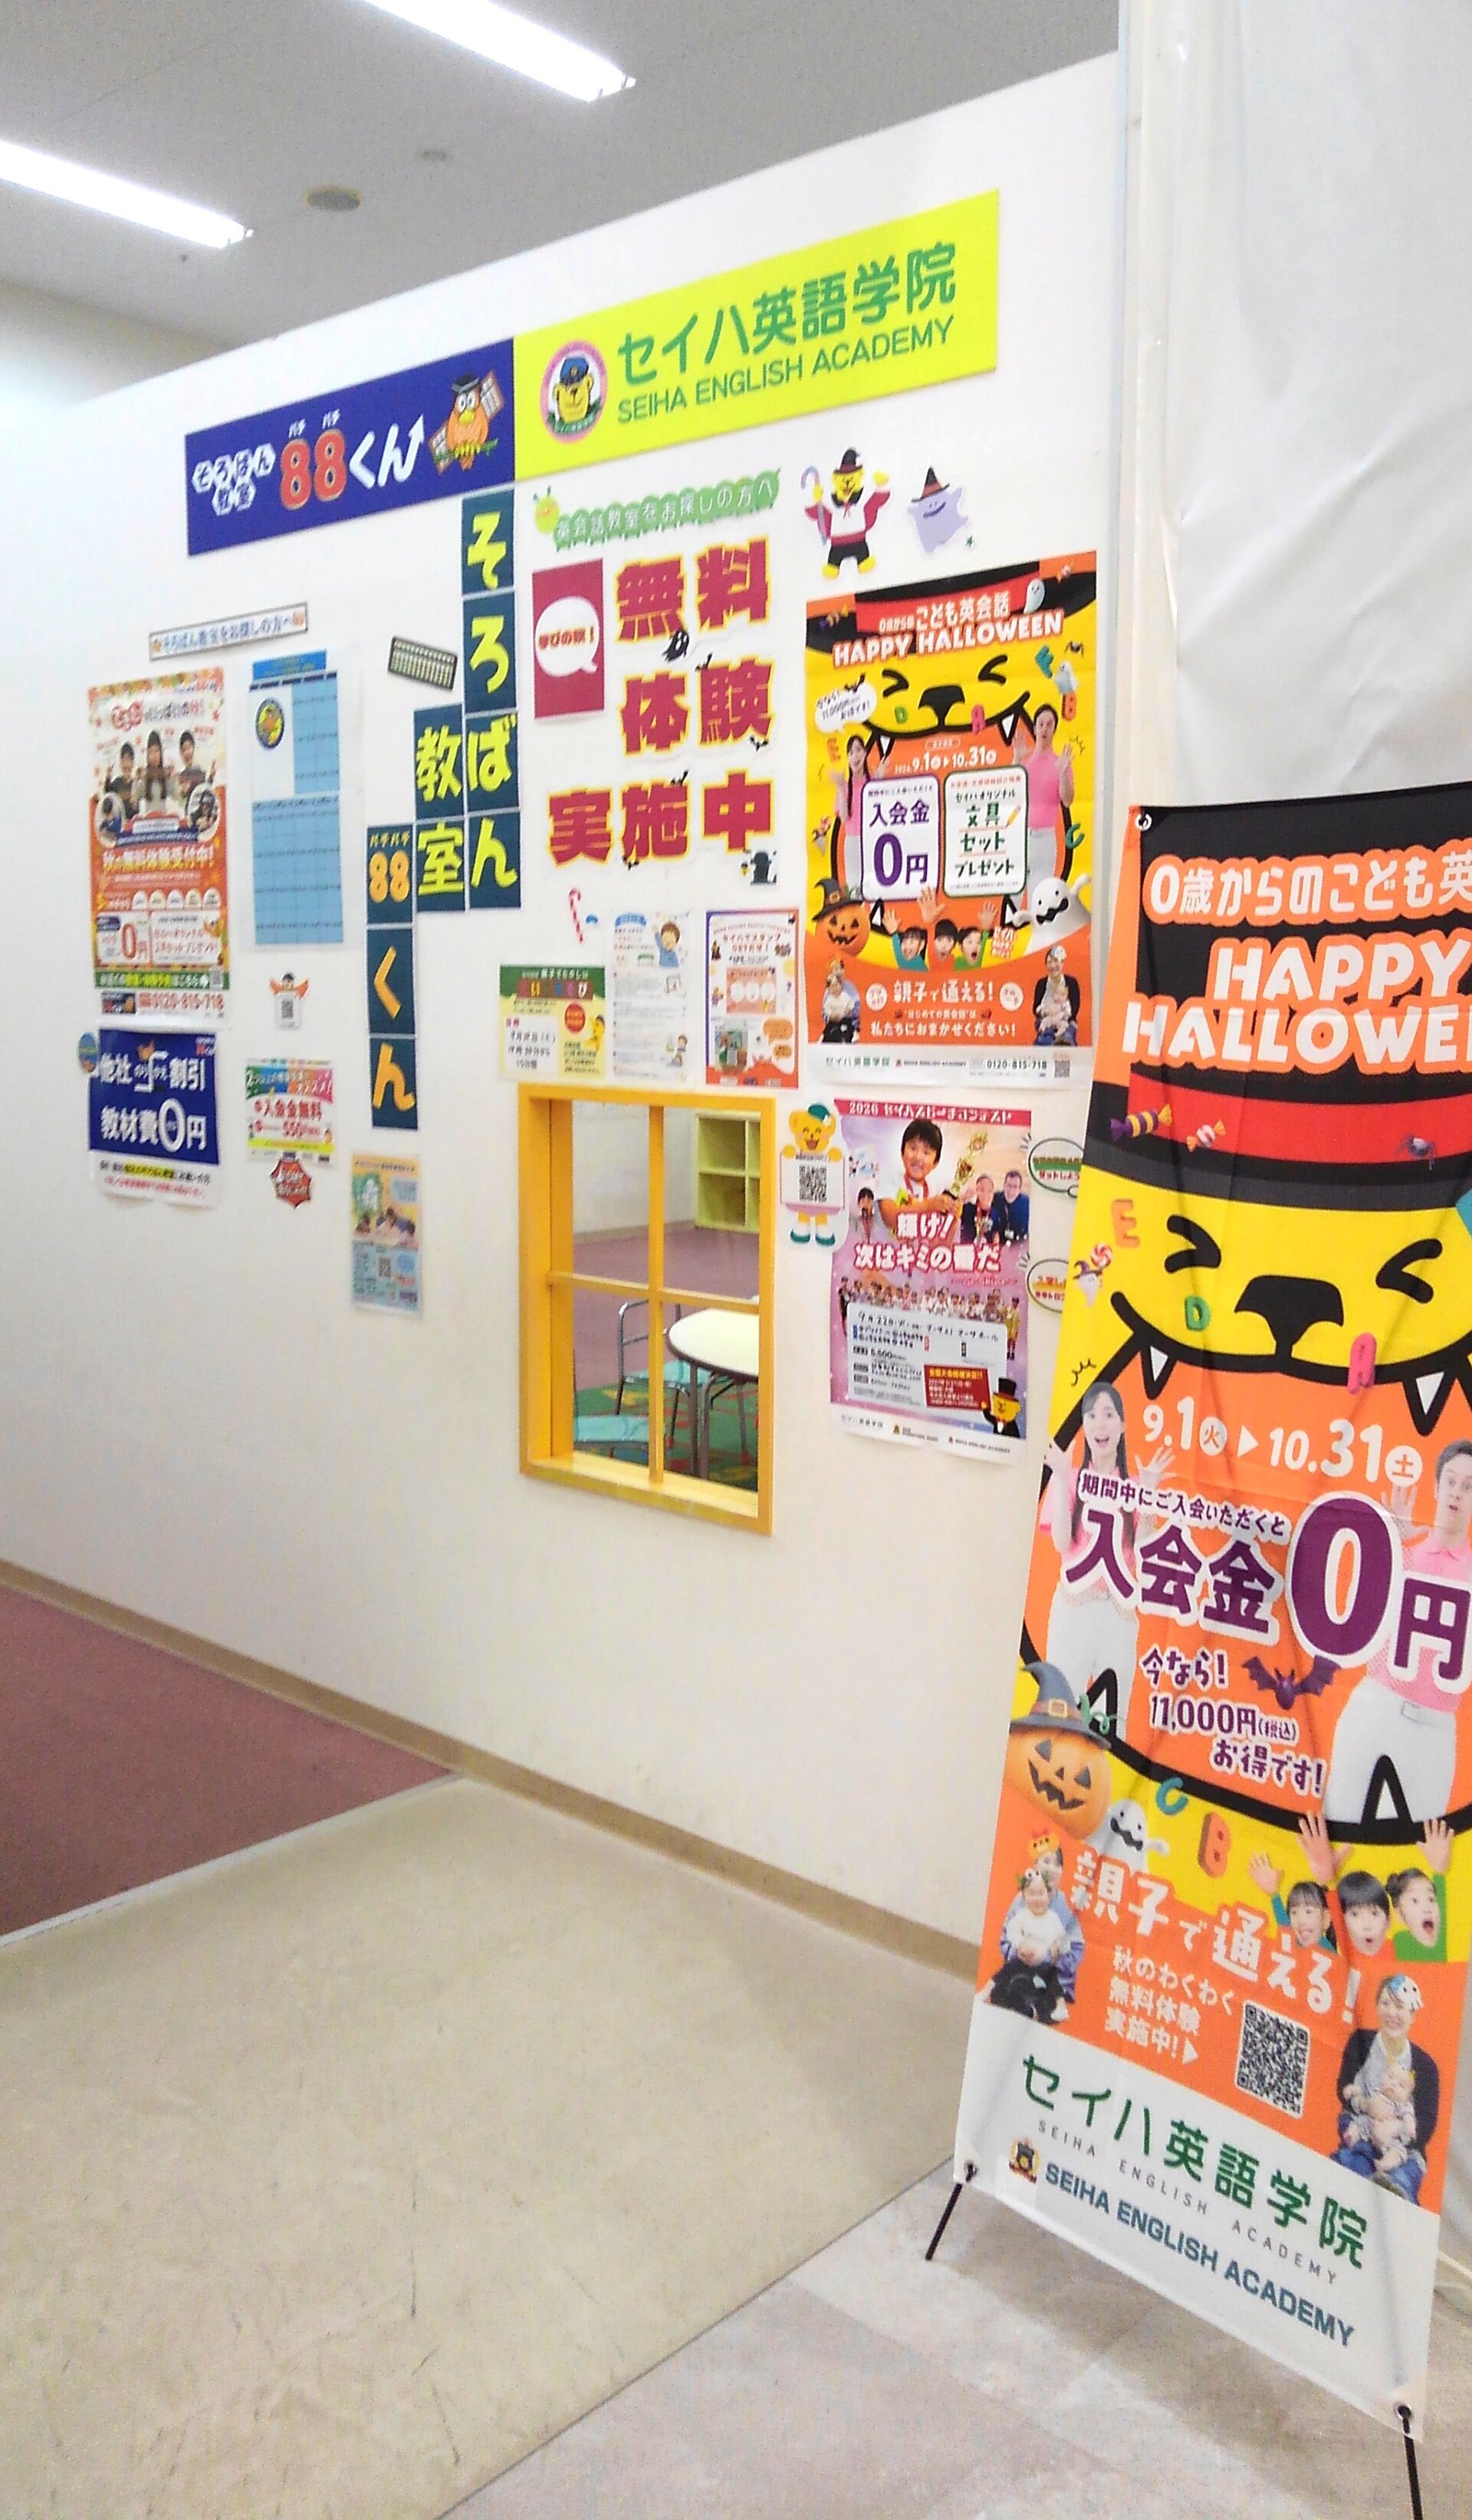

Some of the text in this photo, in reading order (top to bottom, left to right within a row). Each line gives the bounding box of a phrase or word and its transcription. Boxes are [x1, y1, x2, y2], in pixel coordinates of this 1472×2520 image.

[618, 242, 956, 386] セイハ英語学院
[618, 390, 687, 424] SEIHA
[696, 354, 802, 405] ENGLISH
[812, 314, 955, 377] ACADEMY
[616, 536, 770, 643] 無料
[834, 613, 1063, 666] HAPPY HALLOWEEN
[618, 657, 774, 755] 体験
[547, 770, 773, 869] 実施中
[869, 798, 930, 827] 入会金
[960, 831, 1006, 854] セット
[965, 801, 1000, 827] 文具
[954, 857, 1015, 878] プレゼント
[1213, 938, 1471, 1002] HAPPY
[1122, 1002, 1472, 1066] HALLOWE
[849, 1100, 879, 1116] 2026
[896, 1211, 955, 1239] 輝け!
[853, 1242, 1002, 1274] 次はキミの番だ
[1081, 1473, 1286, 1537] 期間中にご入会いただくと
[1142, 1648, 1226, 1687] 今なら!
[1214, 1739, 1323, 1794] お得です!
[1070, 1851, 1360, 2024] 親子で通える!
[1109, 1975, 1201, 2037] 無料体験
[1112, 1943, 1235, 2016] 秋のわくわく
[1104, 2006, 1178, 2059] 実施中!
[1022, 2054, 1370, 2269] セイハ英語学院
[1037, 2119, 1338, 2285] SEIHA ENGLISH ACADEMY
[1045, 2162, 1355, 2347] SEIHA ENGLISH ACADEMY
